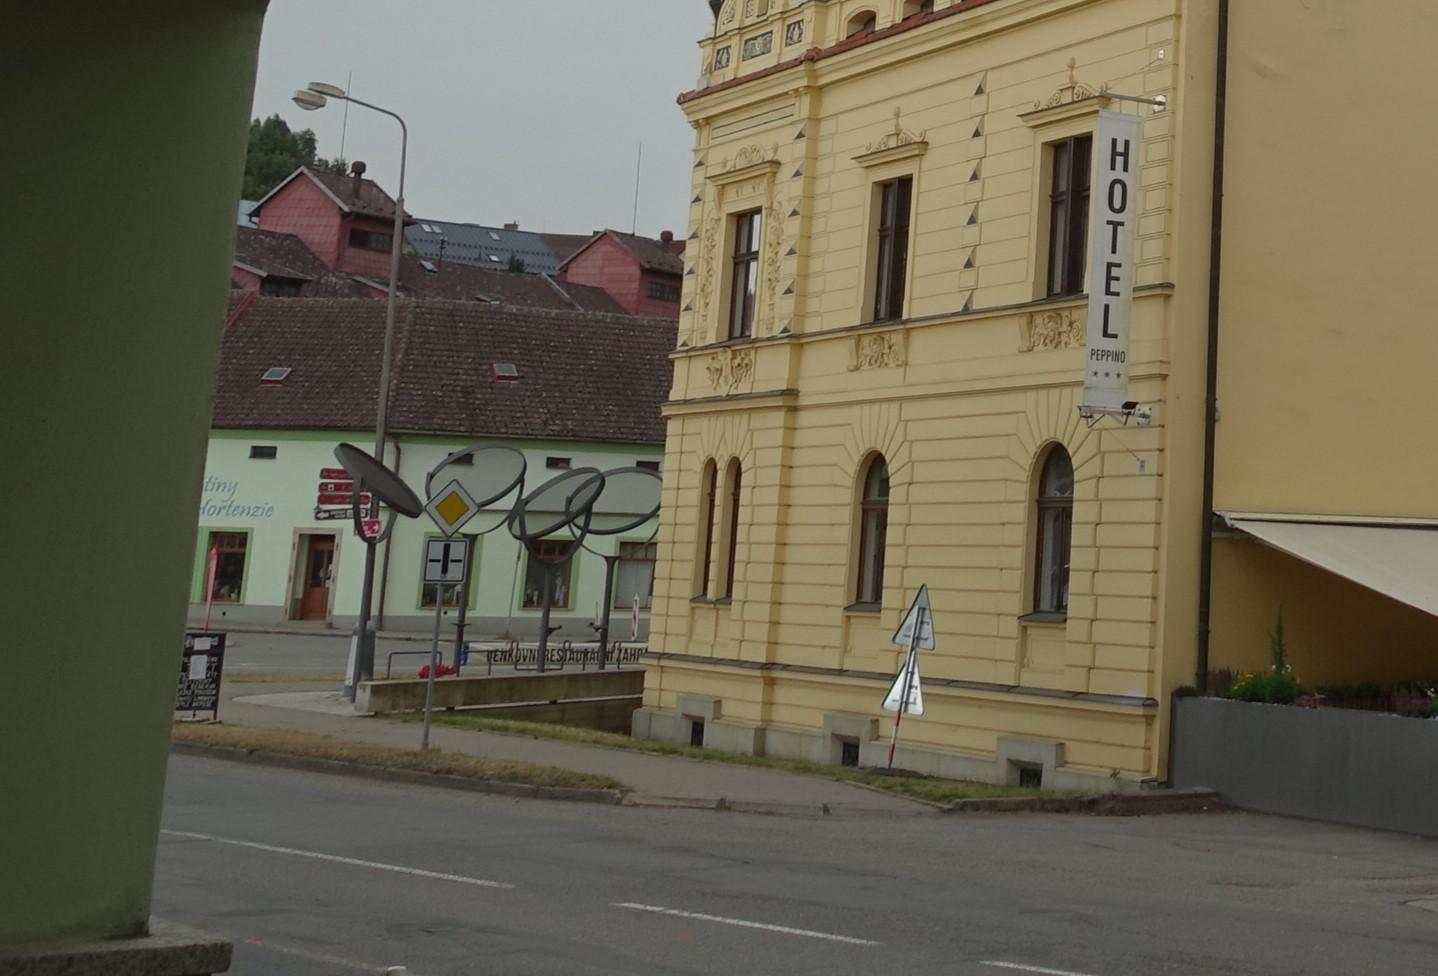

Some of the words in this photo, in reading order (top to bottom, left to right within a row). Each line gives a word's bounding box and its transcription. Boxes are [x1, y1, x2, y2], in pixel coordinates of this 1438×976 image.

[1102, 137, 1130, 339] HOTEL
[1090, 348, 1126, 364] PEPPINO
[204, 475, 239, 502] tiny
[486, 647, 541, 663] VENKOVN
